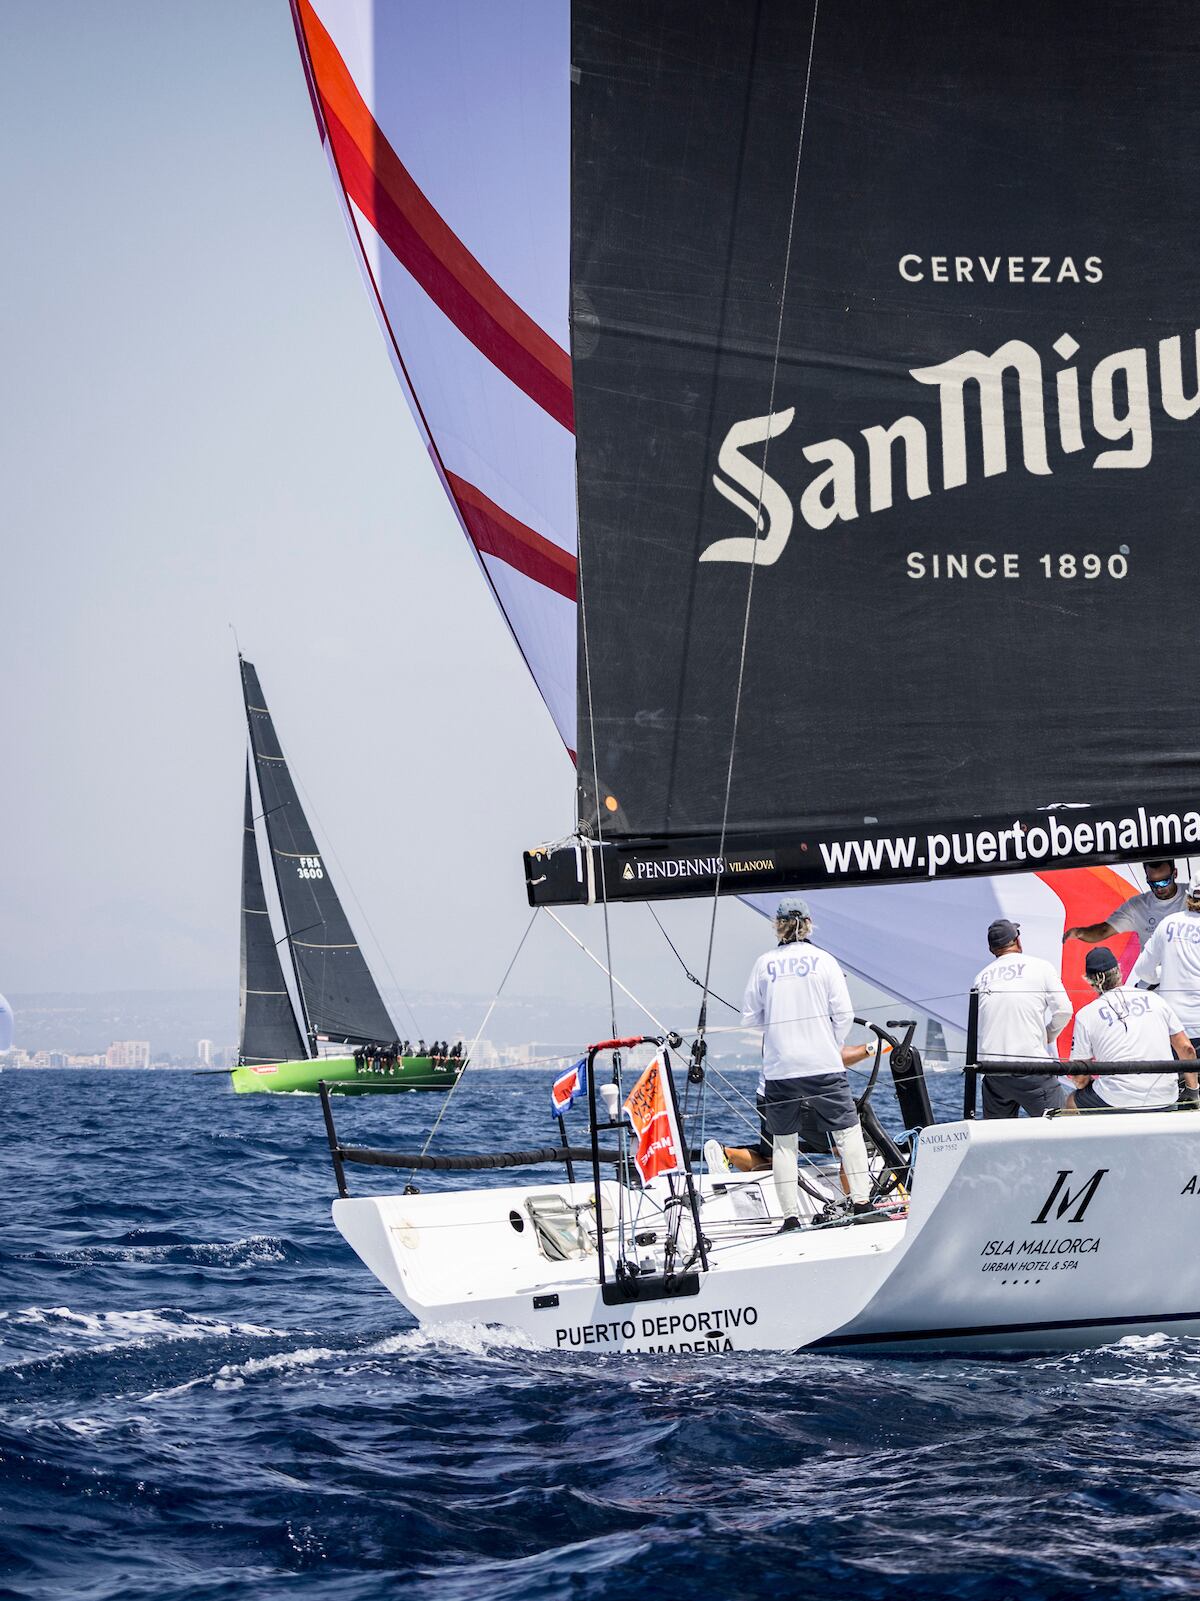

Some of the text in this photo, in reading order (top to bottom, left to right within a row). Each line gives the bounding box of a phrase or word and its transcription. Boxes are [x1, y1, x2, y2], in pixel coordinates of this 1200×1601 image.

[898, 253, 1103, 284] CERVEZAS
[906, 552, 1129, 579] SINCE 1890
[299, 857, 321, 868] FRA
[636, 857, 775, 880] PENDENNIS VILANOVA
[767, 955, 820, 983] GYPSY
[953, 1131, 969, 1141] XIV
[980, 1238, 1101, 1255] ISLA MALLORCA
[981, 1261, 1079, 1272] URBAN HOTEL & SPA
[556, 1306, 758, 1347] PUERTO DEPORTIVO
